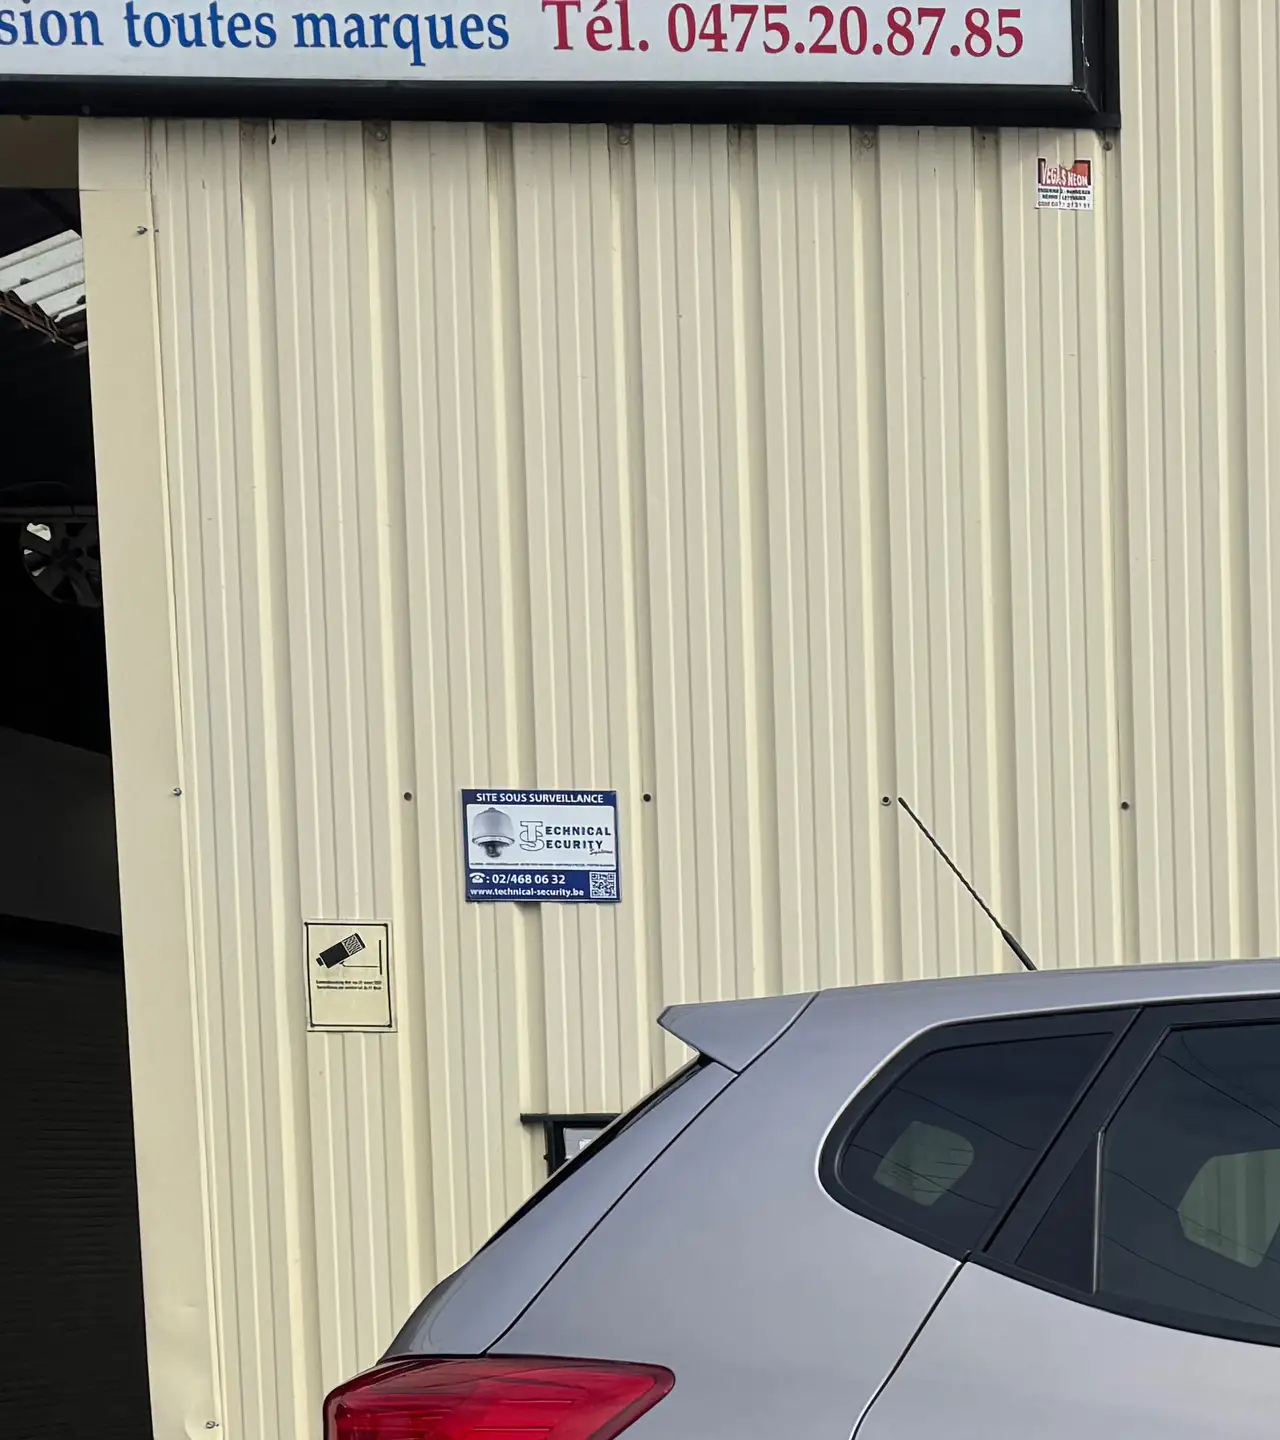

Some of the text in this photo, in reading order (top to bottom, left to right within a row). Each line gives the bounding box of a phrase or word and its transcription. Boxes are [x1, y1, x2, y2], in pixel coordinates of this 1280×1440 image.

[0, 0, 509, 66] sion toutes marques
[542, 0, 1024, 57] Tél. 0475.20.87.85
[476, 793, 604, 804] SITE SOUS SURVEILLANCE
[491, 873, 532, 885] 02/468
[535, 874, 549, 885] 06
[551, 874, 566, 885] 32
[469, 887, 585, 898] www.technical-security.be
